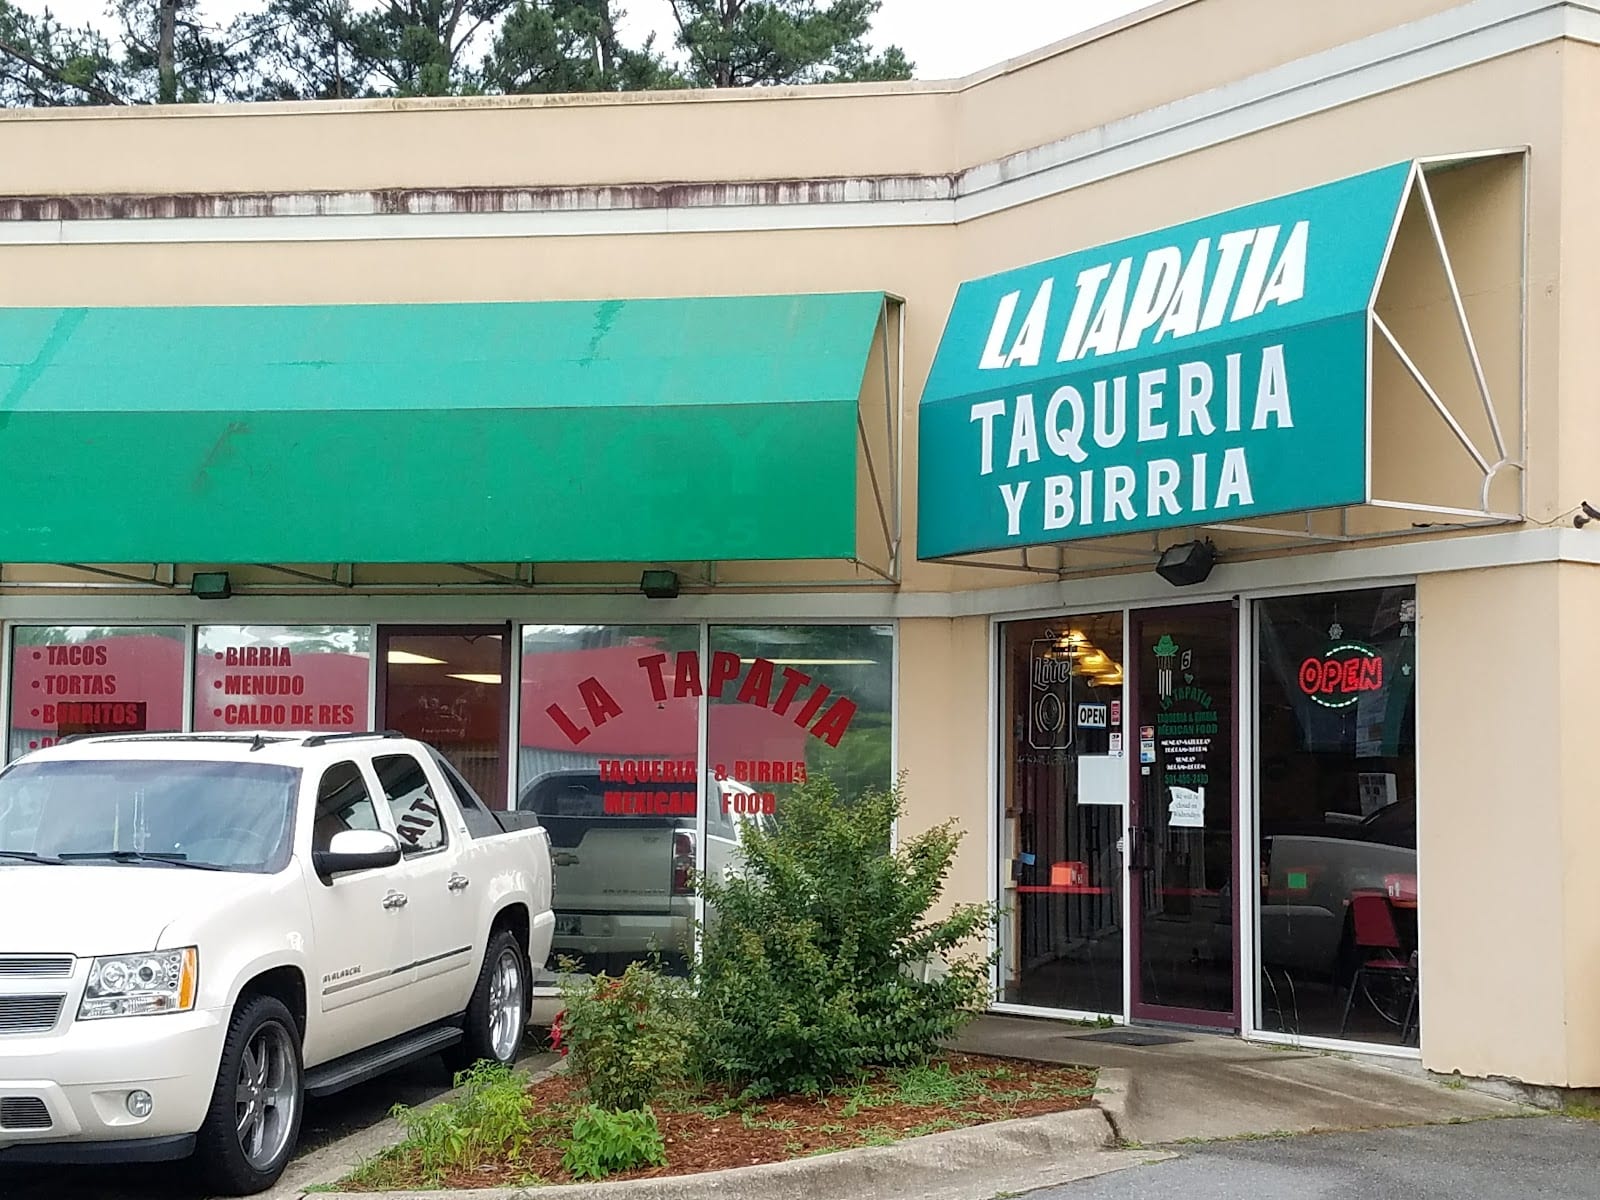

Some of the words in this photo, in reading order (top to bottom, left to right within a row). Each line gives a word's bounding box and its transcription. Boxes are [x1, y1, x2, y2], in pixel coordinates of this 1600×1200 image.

[978, 277, 1054, 370] LA
[1056, 220, 1310, 364] TAPATIA
[969, 343, 1295, 477] TAQUERIA
[998, 480, 1031, 537] Y
[1043, 446, 1255, 532] BIRRIA
[46, 645, 108, 667] TACOS
[225, 646, 292, 668] BIRRIA
[1033, 656, 1071, 691] Lite
[1298, 656, 1384, 695] OPEN
[45, 674, 117, 696] TORTAS
[224, 675, 305, 697] MENUDO
[545, 676, 624, 746] LA
[637, 650, 858, 749] TAPATIA
[42, 703, 139, 725] BURRITOS
[224, 704, 286, 726] CALDO
[291, 704, 314, 725] DE
[318, 704, 355, 725] RES
[1079, 707, 1106, 725] OPEN
[598, 760, 698, 785] TAQUERIA
[714, 764, 729, 782] &
[734, 761, 809, 784] BIRRIA
[603, 792, 698, 815] MEXICAN
[721, 792, 777, 815] FOOD
[322, 964, 361, 984] AVALANCHE
